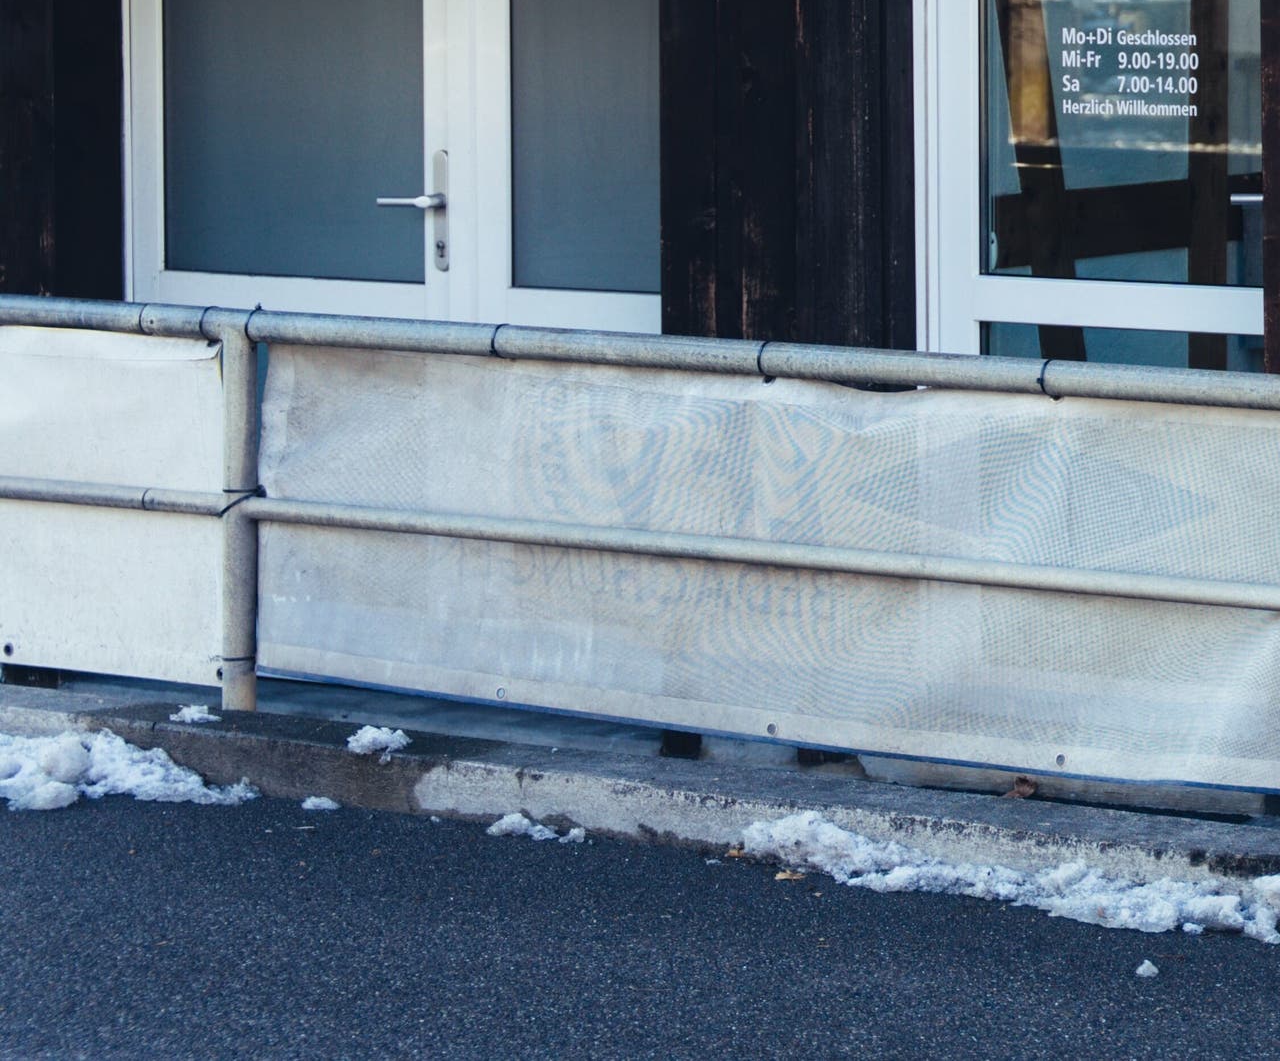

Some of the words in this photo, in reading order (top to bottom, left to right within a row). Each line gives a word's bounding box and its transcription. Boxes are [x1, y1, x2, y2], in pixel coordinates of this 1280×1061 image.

[1062, 27, 1112, 45] Mo+Di
[1117, 29, 1197, 46] Geschlossen
[1062, 50, 1101, 68] Mi-Fr
[1117, 52, 1199, 70] 9.00-19.00
[1062, 74, 1080, 92] Sa
[1117, 76, 1198, 94] 7.00-14.00
[1062, 99, 1114, 115] Herzlich
[1116, 100, 1198, 117] Willkommen
